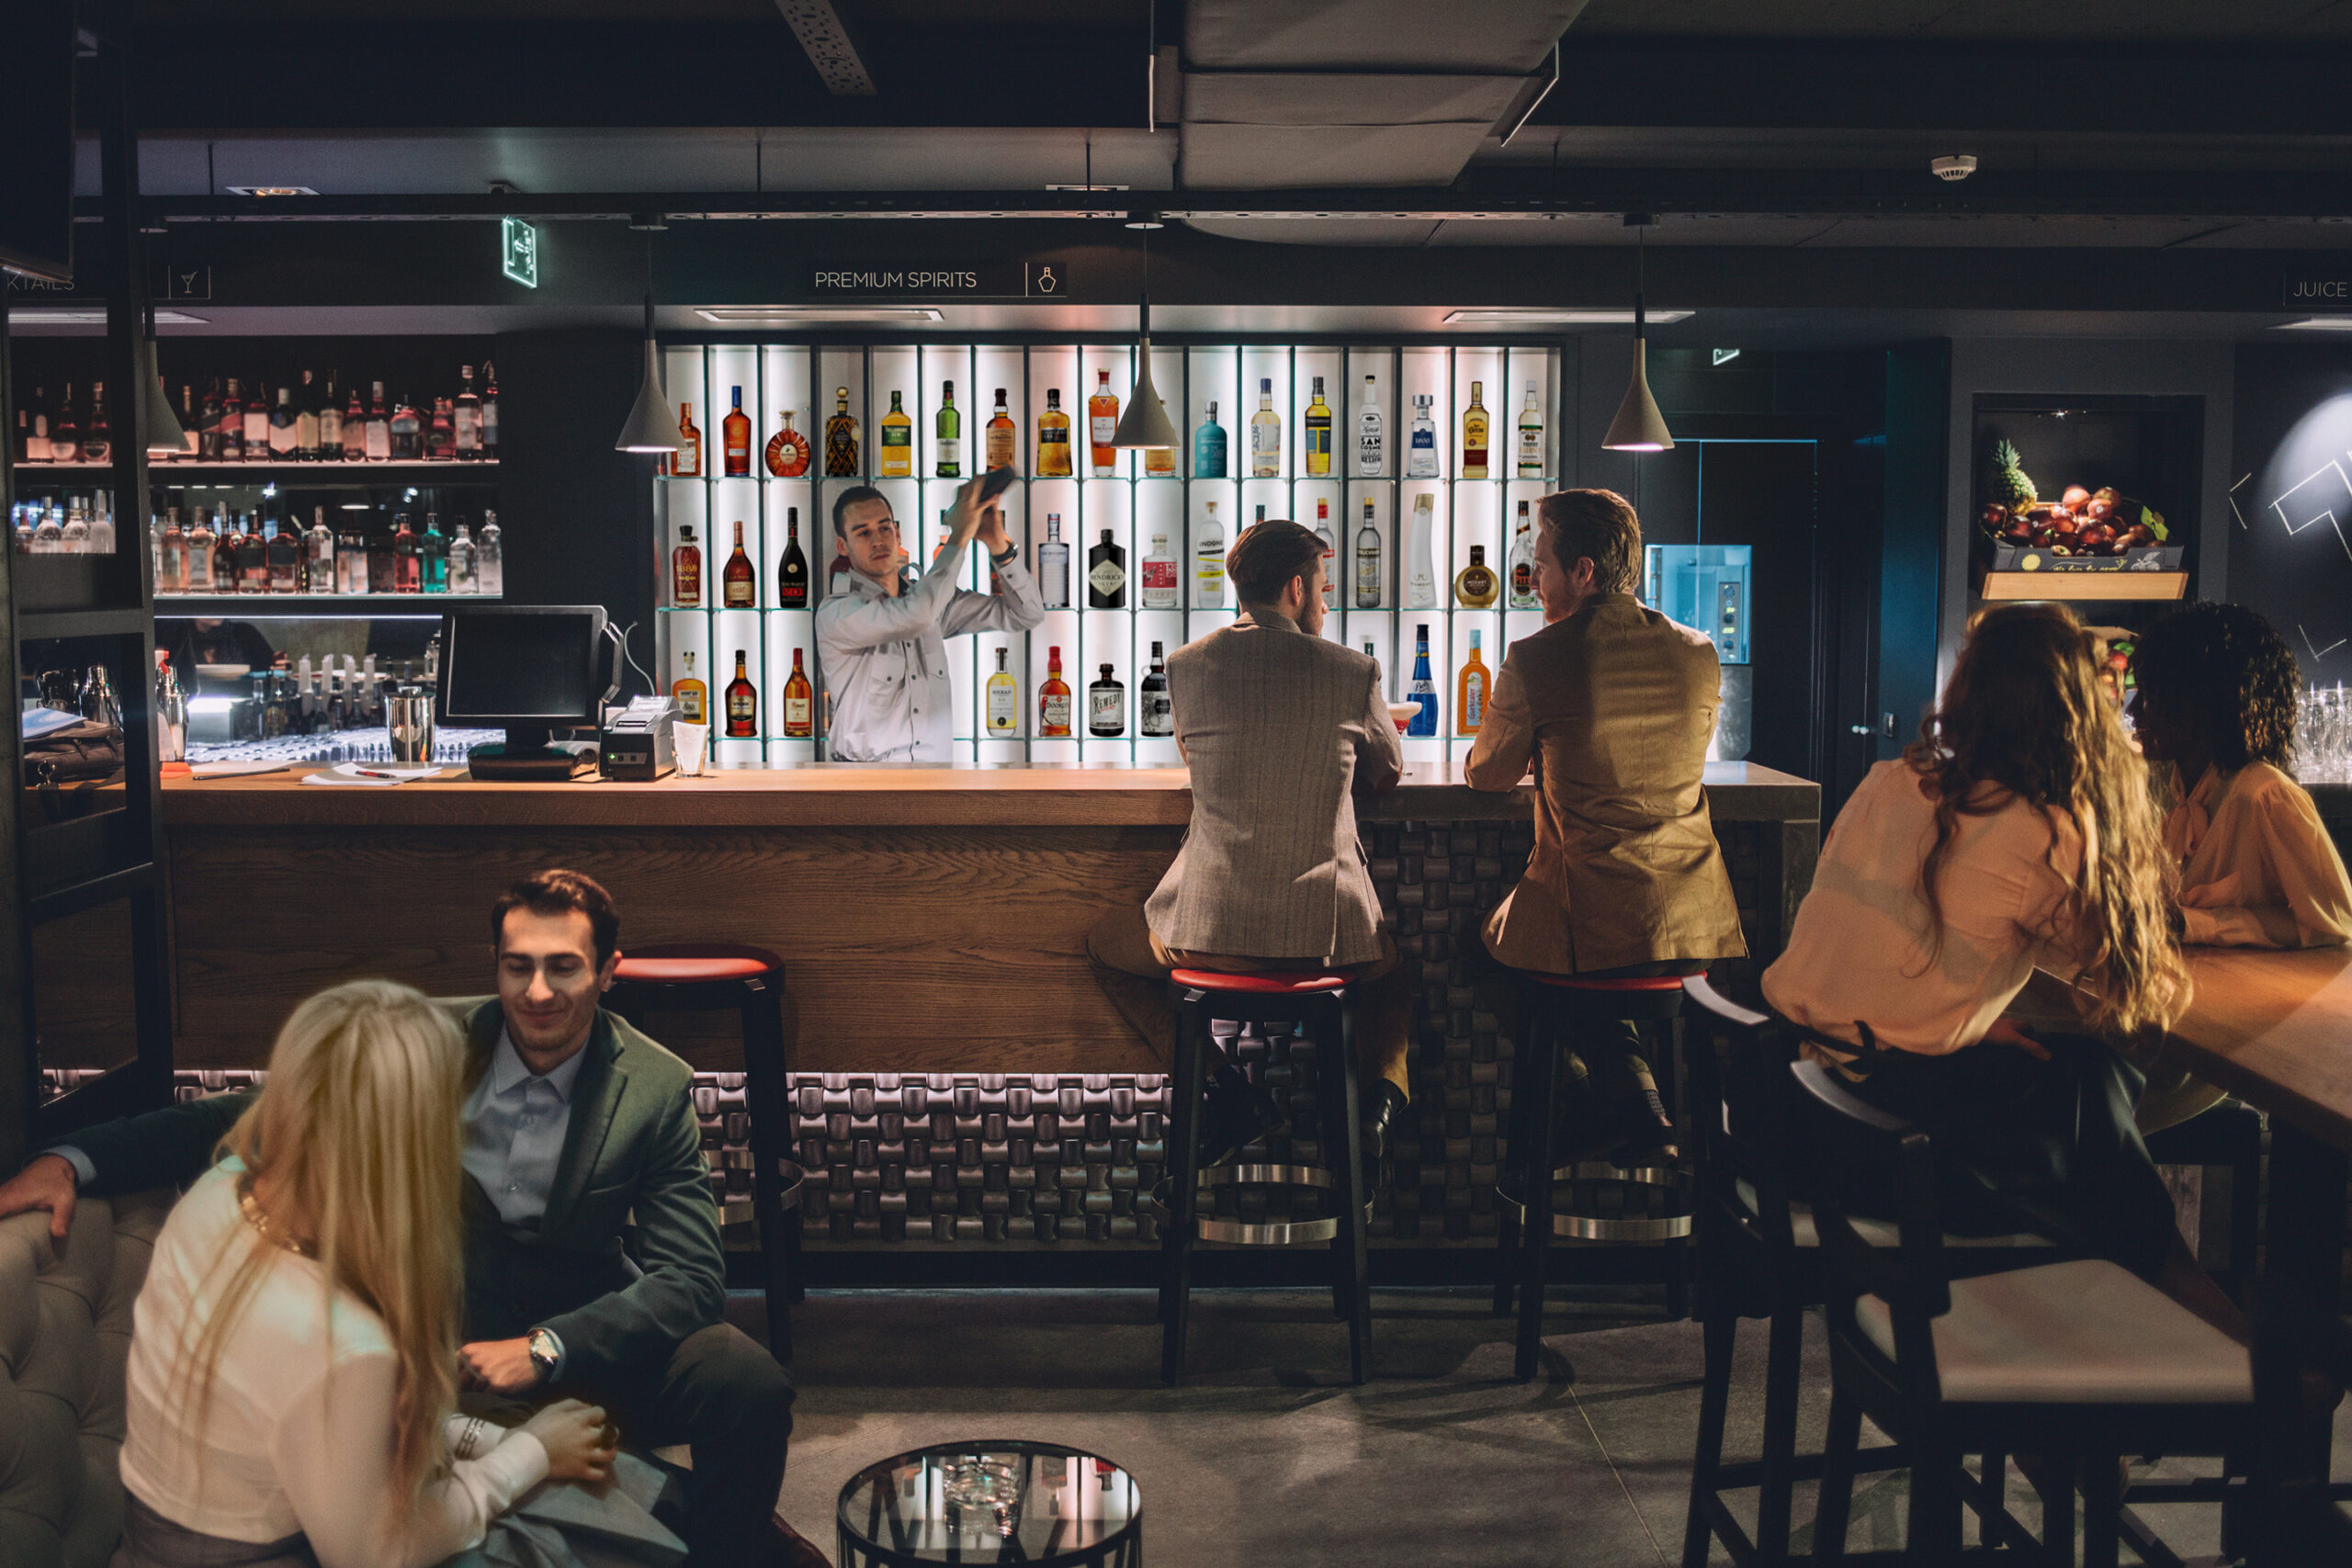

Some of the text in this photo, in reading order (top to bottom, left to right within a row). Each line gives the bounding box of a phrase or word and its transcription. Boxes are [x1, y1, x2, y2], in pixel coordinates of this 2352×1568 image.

[815, 271, 978, 288] PREMIUM SPIRITS
[2292, 280, 2348, 298] JUICE
[1361, 437, 1381, 446] SAN
[1093, 694, 1121, 715] REMEDY
